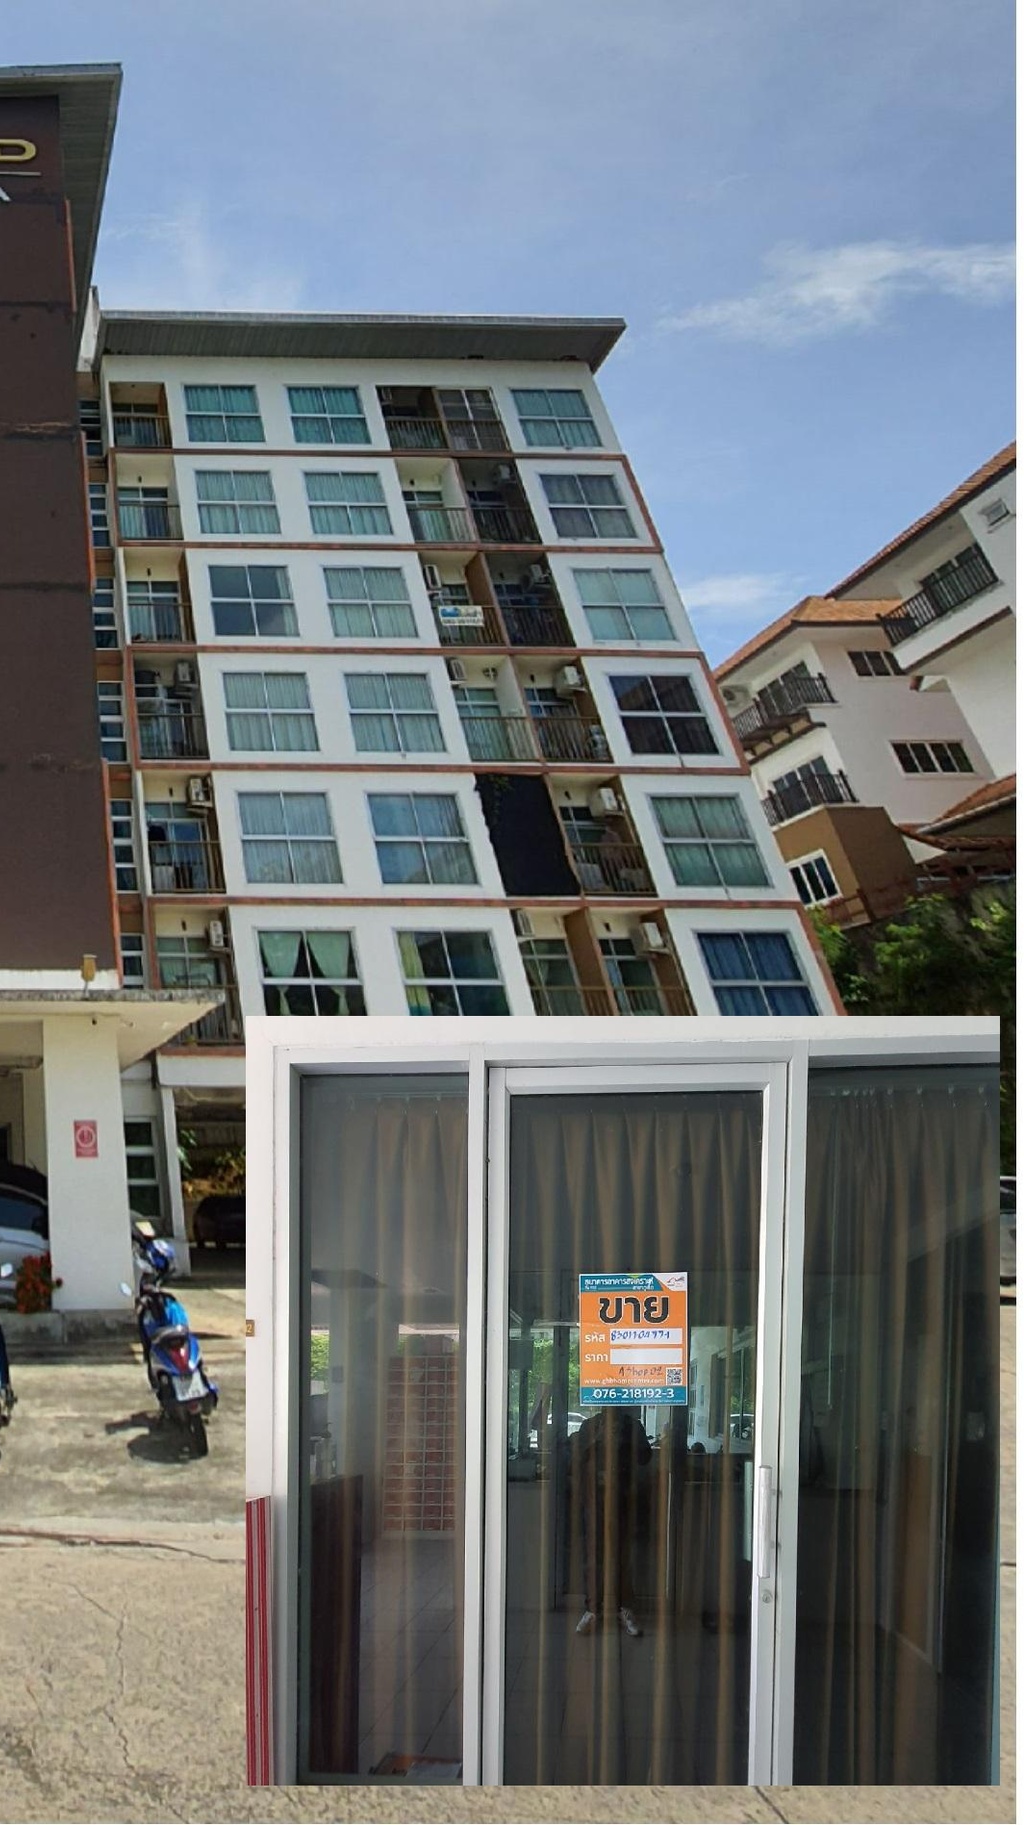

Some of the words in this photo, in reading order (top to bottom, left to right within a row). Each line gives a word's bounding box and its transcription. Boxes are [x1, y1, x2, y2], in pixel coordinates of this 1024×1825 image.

[599, 1295, 669, 1324] ขาย
[585, 1331, 605, 1342] รหัส
[584, 1353, 609, 1362] ราคา
[593, 1388, 675, 1399] 076-218192-3
